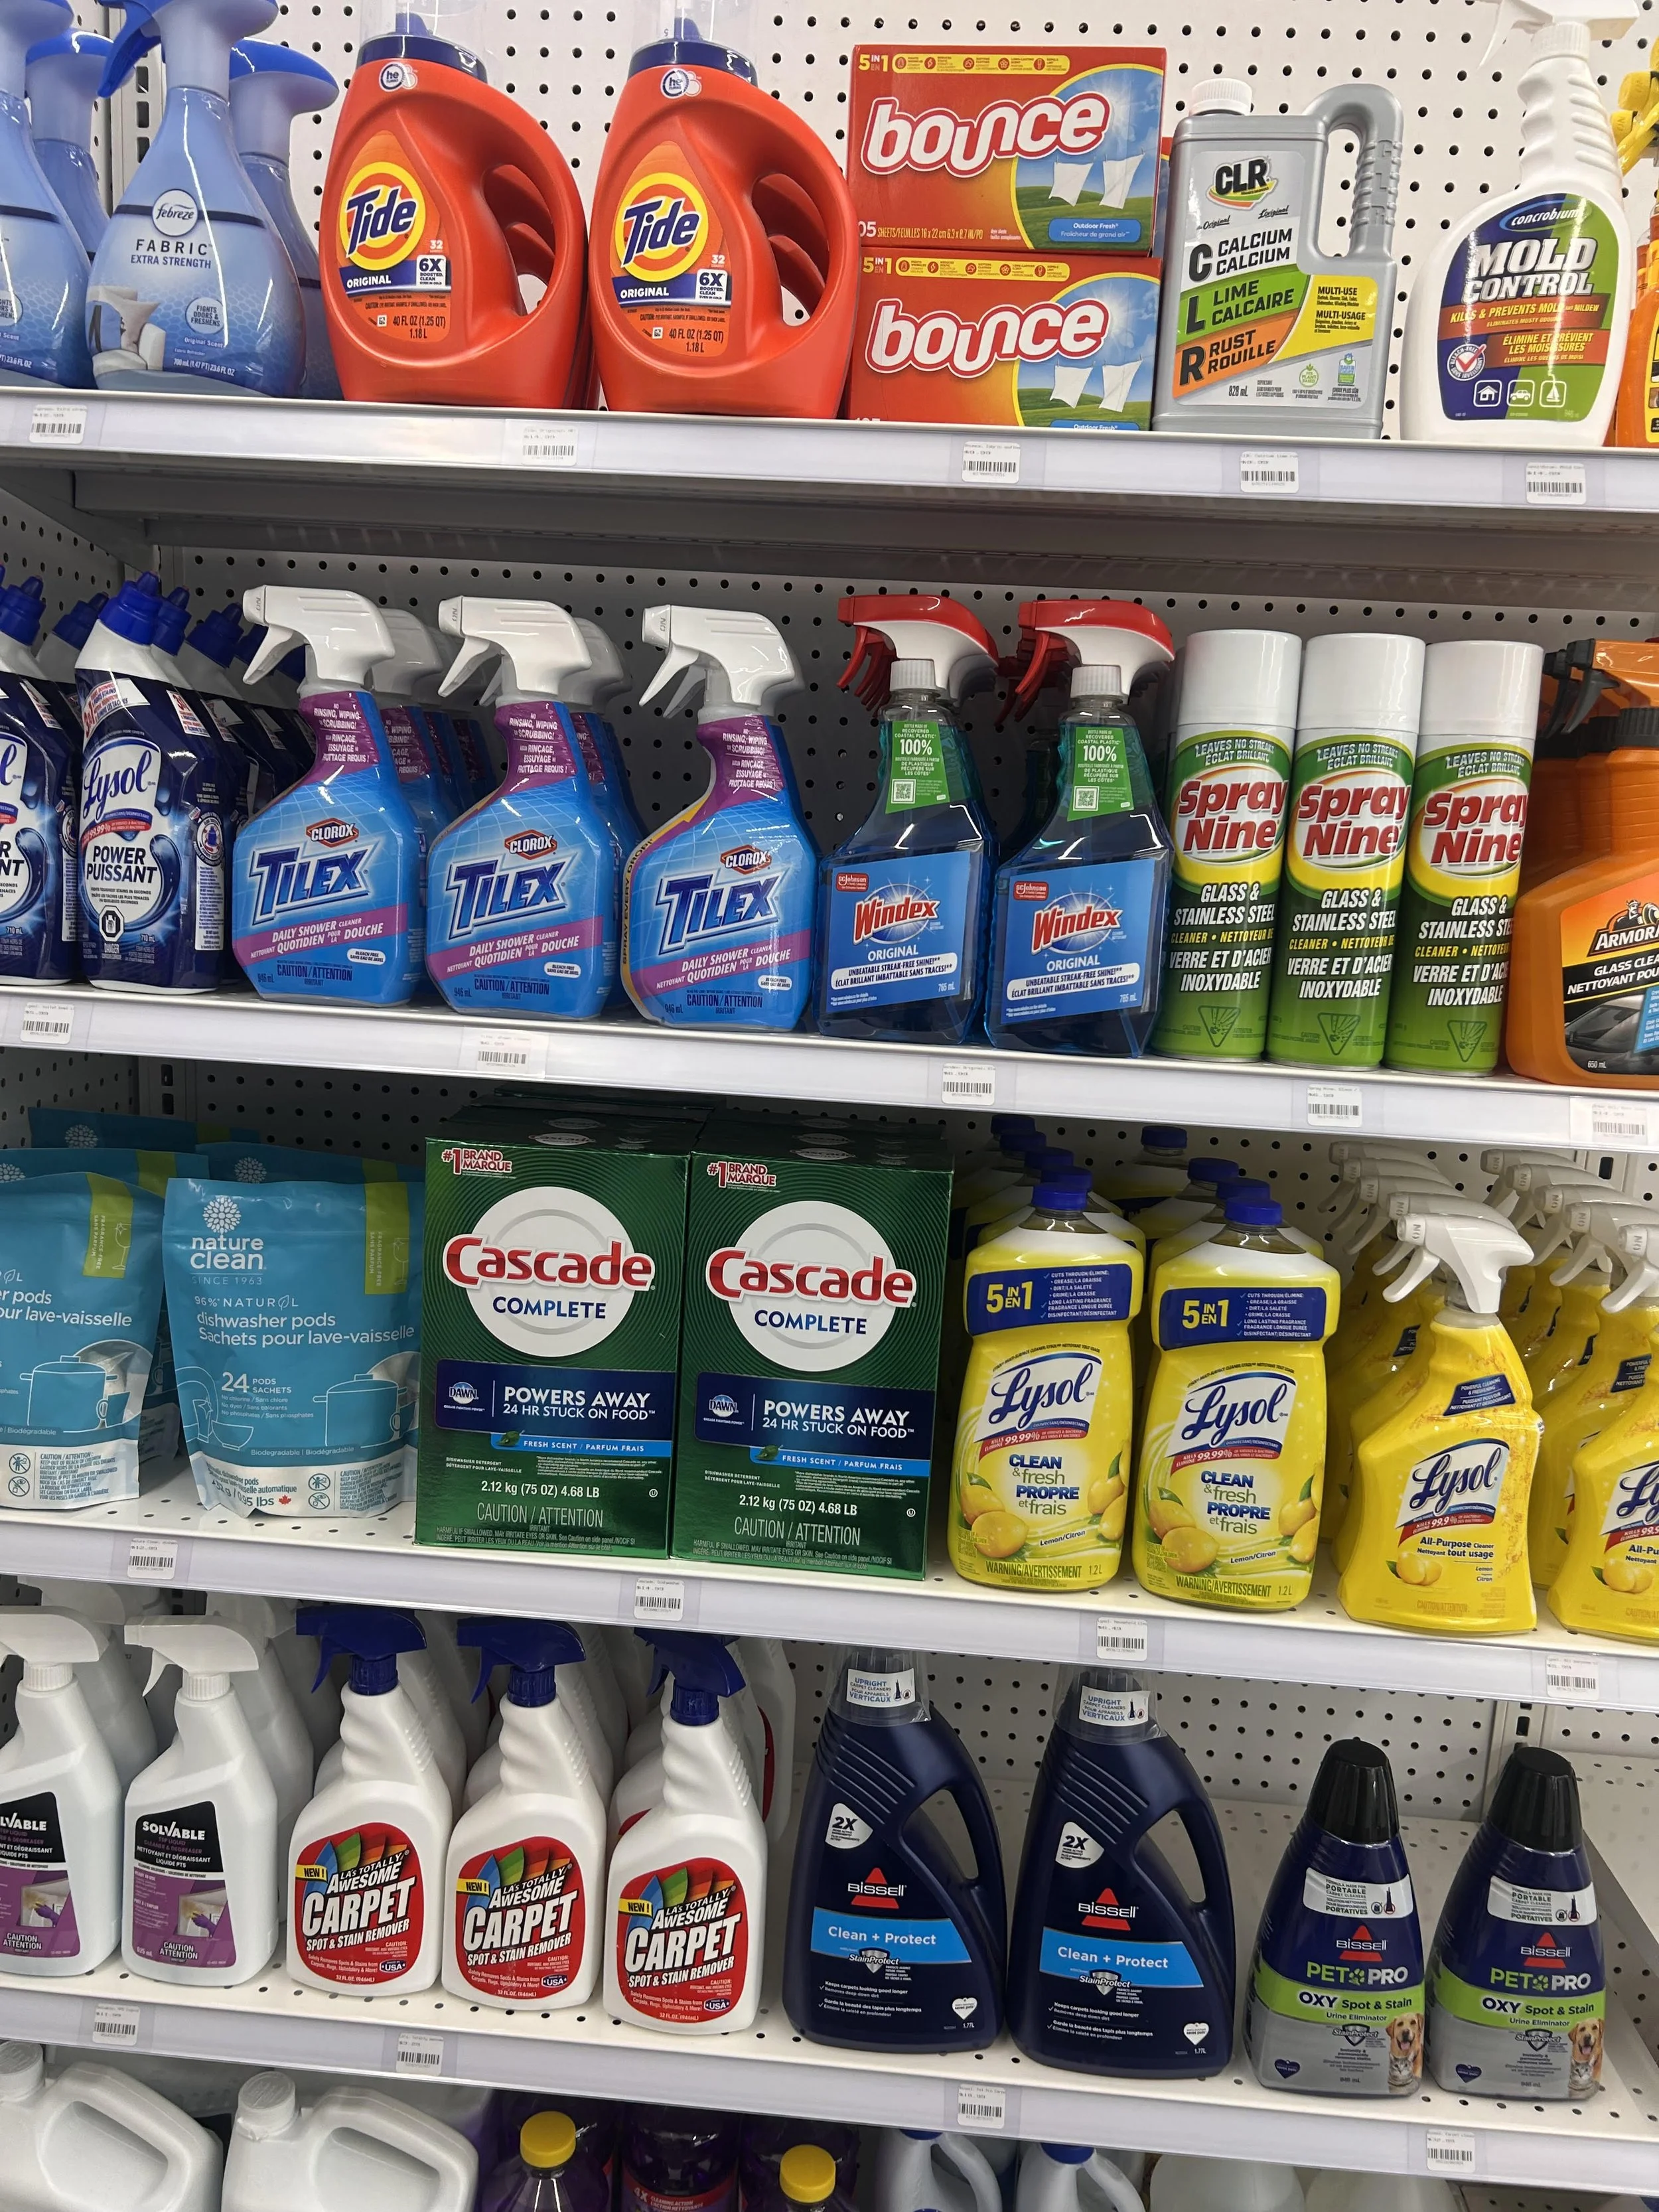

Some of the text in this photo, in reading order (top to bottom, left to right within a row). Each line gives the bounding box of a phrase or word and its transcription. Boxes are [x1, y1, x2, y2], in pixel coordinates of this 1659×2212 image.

[864, 93, 1108, 177] bounce
[1215, 158, 1267, 196] CLR
[156, 202, 194, 220] febreze
[1511, 206, 1581, 226] concrobium
[346, 187, 417, 257] Tide
[622, 198, 700, 267] Tide
[1218, 228, 1293, 257] CALCIUM
[136, 239, 208, 256] FABRIC
[1475, 238, 1598, 276] MOLD
[131, 255, 212, 269] EXTRA STRENGTH
[419, 258, 442, 272] 6X
[1216, 246, 1290, 275] CALCIUM
[346, 275, 392, 288] ORIGINAL
[1318, 286, 1358, 296] MULTI-USE
[1462, 271, 1594, 304] CONTROL
[1213, 279, 1259, 307] LIME
[194, 311, 212, 320] ODORS
[196, 305, 218, 314] FIGHTS
[1212, 289, 1294, 327] CALCAIRE
[1316, 311, 1366, 321] MULTI-USAGE
[191, 318, 220, 327] FRESHENS
[867, 300, 1107, 378] bounce
[1210, 329, 1256, 357] RUST
[1208, 340, 1276, 374] ROUILLE
[900, 739, 932, 755] 100%
[1194, 739, 1247, 757] LEAVES NO
[82, 749, 153, 823] Lysol
[1178, 780, 1289, 818] Spray
[1298, 785, 1410, 822] Spray
[310, 825, 354, 842] CLOROX
[1183, 815, 1278, 852] Nine
[1303, 820, 1399, 859] Nine
[93, 846, 146, 864] POWER
[86, 863, 158, 884] PUISSANT
[1200, 883, 1260, 903] GLASS &
[854, 900, 938, 941] Windex
[1173, 903, 1275, 926] STAINLESS STEEL
[250, 946, 275, 958] NETTOYANT
[277, 935, 325, 954] QUOTIDIEN
[344, 922, 383, 940] DOUCHE
[272, 917, 362, 943] DAILY SHOWER CLEANER
[1033, 909, 1121, 952] Windex
[1171, 928, 1266, 944] CLEANER NETTOYEUR
[848, 964, 879, 976] UNBEATABLE
[881, 960, 914, 972] STREAK-FREE
[1169, 950, 1207, 969] VERRE
[1211, 949, 1227, 967] ET
[835, 976, 849, 987] ÉCLAT
[850, 974, 874, 986] BRILLANT
[876, 970, 908, 982] IMBATTABLE
[909, 968, 923, 978] SANS
[1181, 971, 1261, 992] INOXYDABLE
[1567, 972, 1634, 994] NETTOYANT
[463, 1151, 502, 1161] BRAND
[463, 1160, 512, 1172] MARQUE
[192, 1235, 264, 1252] nature
[190, 1251, 263, 1270] clean
[445, 1236, 653, 1288] Cascade
[192, 1276, 262, 1285] SINCE 1963
[709, 1250, 913, 1303] Cascade
[493, 1296, 606, 1319] COMPLETE
[197, 1312, 336, 1333] dishwasher pods
[199, 1326, 415, 1348] Sachets pour lave-vaisselle
[222, 1372, 250, 1392] 24
[252, 1386, 292, 1394] SACHETS
[449, 1386, 477, 1399] DAWN
[504, 1386, 651, 1408] POWERS AWAY
[989, 1363, 1094, 1430] Lysol
[503, 1403, 518, 1414] 24
[522, 1405, 539, 1416] HR
[543, 1407, 585, 1418] STUCK
[588, 1408, 609, 1419] ON
[1181, 1384, 1287, 1446] Lysol
[251, 1448, 300, 1457] Biodegradable
[1009, 1454, 1062, 1468] CLEAN
[1012, 1467, 1065, 1485] & fresh
[1409, 1447, 1501, 1513] Lysol
[481, 1480, 599, 1498] 2.12 kg (75 OZ) 4.68 LB
[1016, 1485, 1080, 1500] PROPRE
[256, 1497, 274, 1507] lbs
[1019, 1499, 1066, 1516] et frais
[1040, 1529, 1086, 1547] Lemon/Citron
[1419, 1536, 1471, 1549] All-Purpose
[1469, 1550, 1494, 1559] usage
[985, 1560, 1082, 1578] WARNING/AVERTISSEMENT
[855, 1676, 887, 1688] UPRIGHT
[849, 1691, 892, 1703] VERTICAUX
[142, 1821, 205, 1840] SOLVABLE
[831, 1816, 857, 1831] 2X
[137, 1846, 165, 1858] NETTOYANT
[173, 1854, 211, 1863] DÉGRAISSANT
[156, 1858, 175, 1867] LIQUIDE
[327, 1861, 403, 1893] AWESOME
[1326, 1883, 1366, 1895] PORTABLE
[302, 1876, 417, 1937] CARPET
[1326, 1906, 1368, 1915] PORTATIVES
[463, 1890, 579, 1951] CARPET
[307, 1919, 410, 1951] SPOT & STAIN REMOVER
[624, 1913, 742, 1972] CARPET
[828, 1926, 865, 1942] Clean
[885, 1931, 936, 1946] Protect
[848, 1952, 900, 1966] StainProtect
[1307, 1962, 1408, 1985] PET PRO
[1299, 1992, 1412, 2012] OXY Spot & Stain
